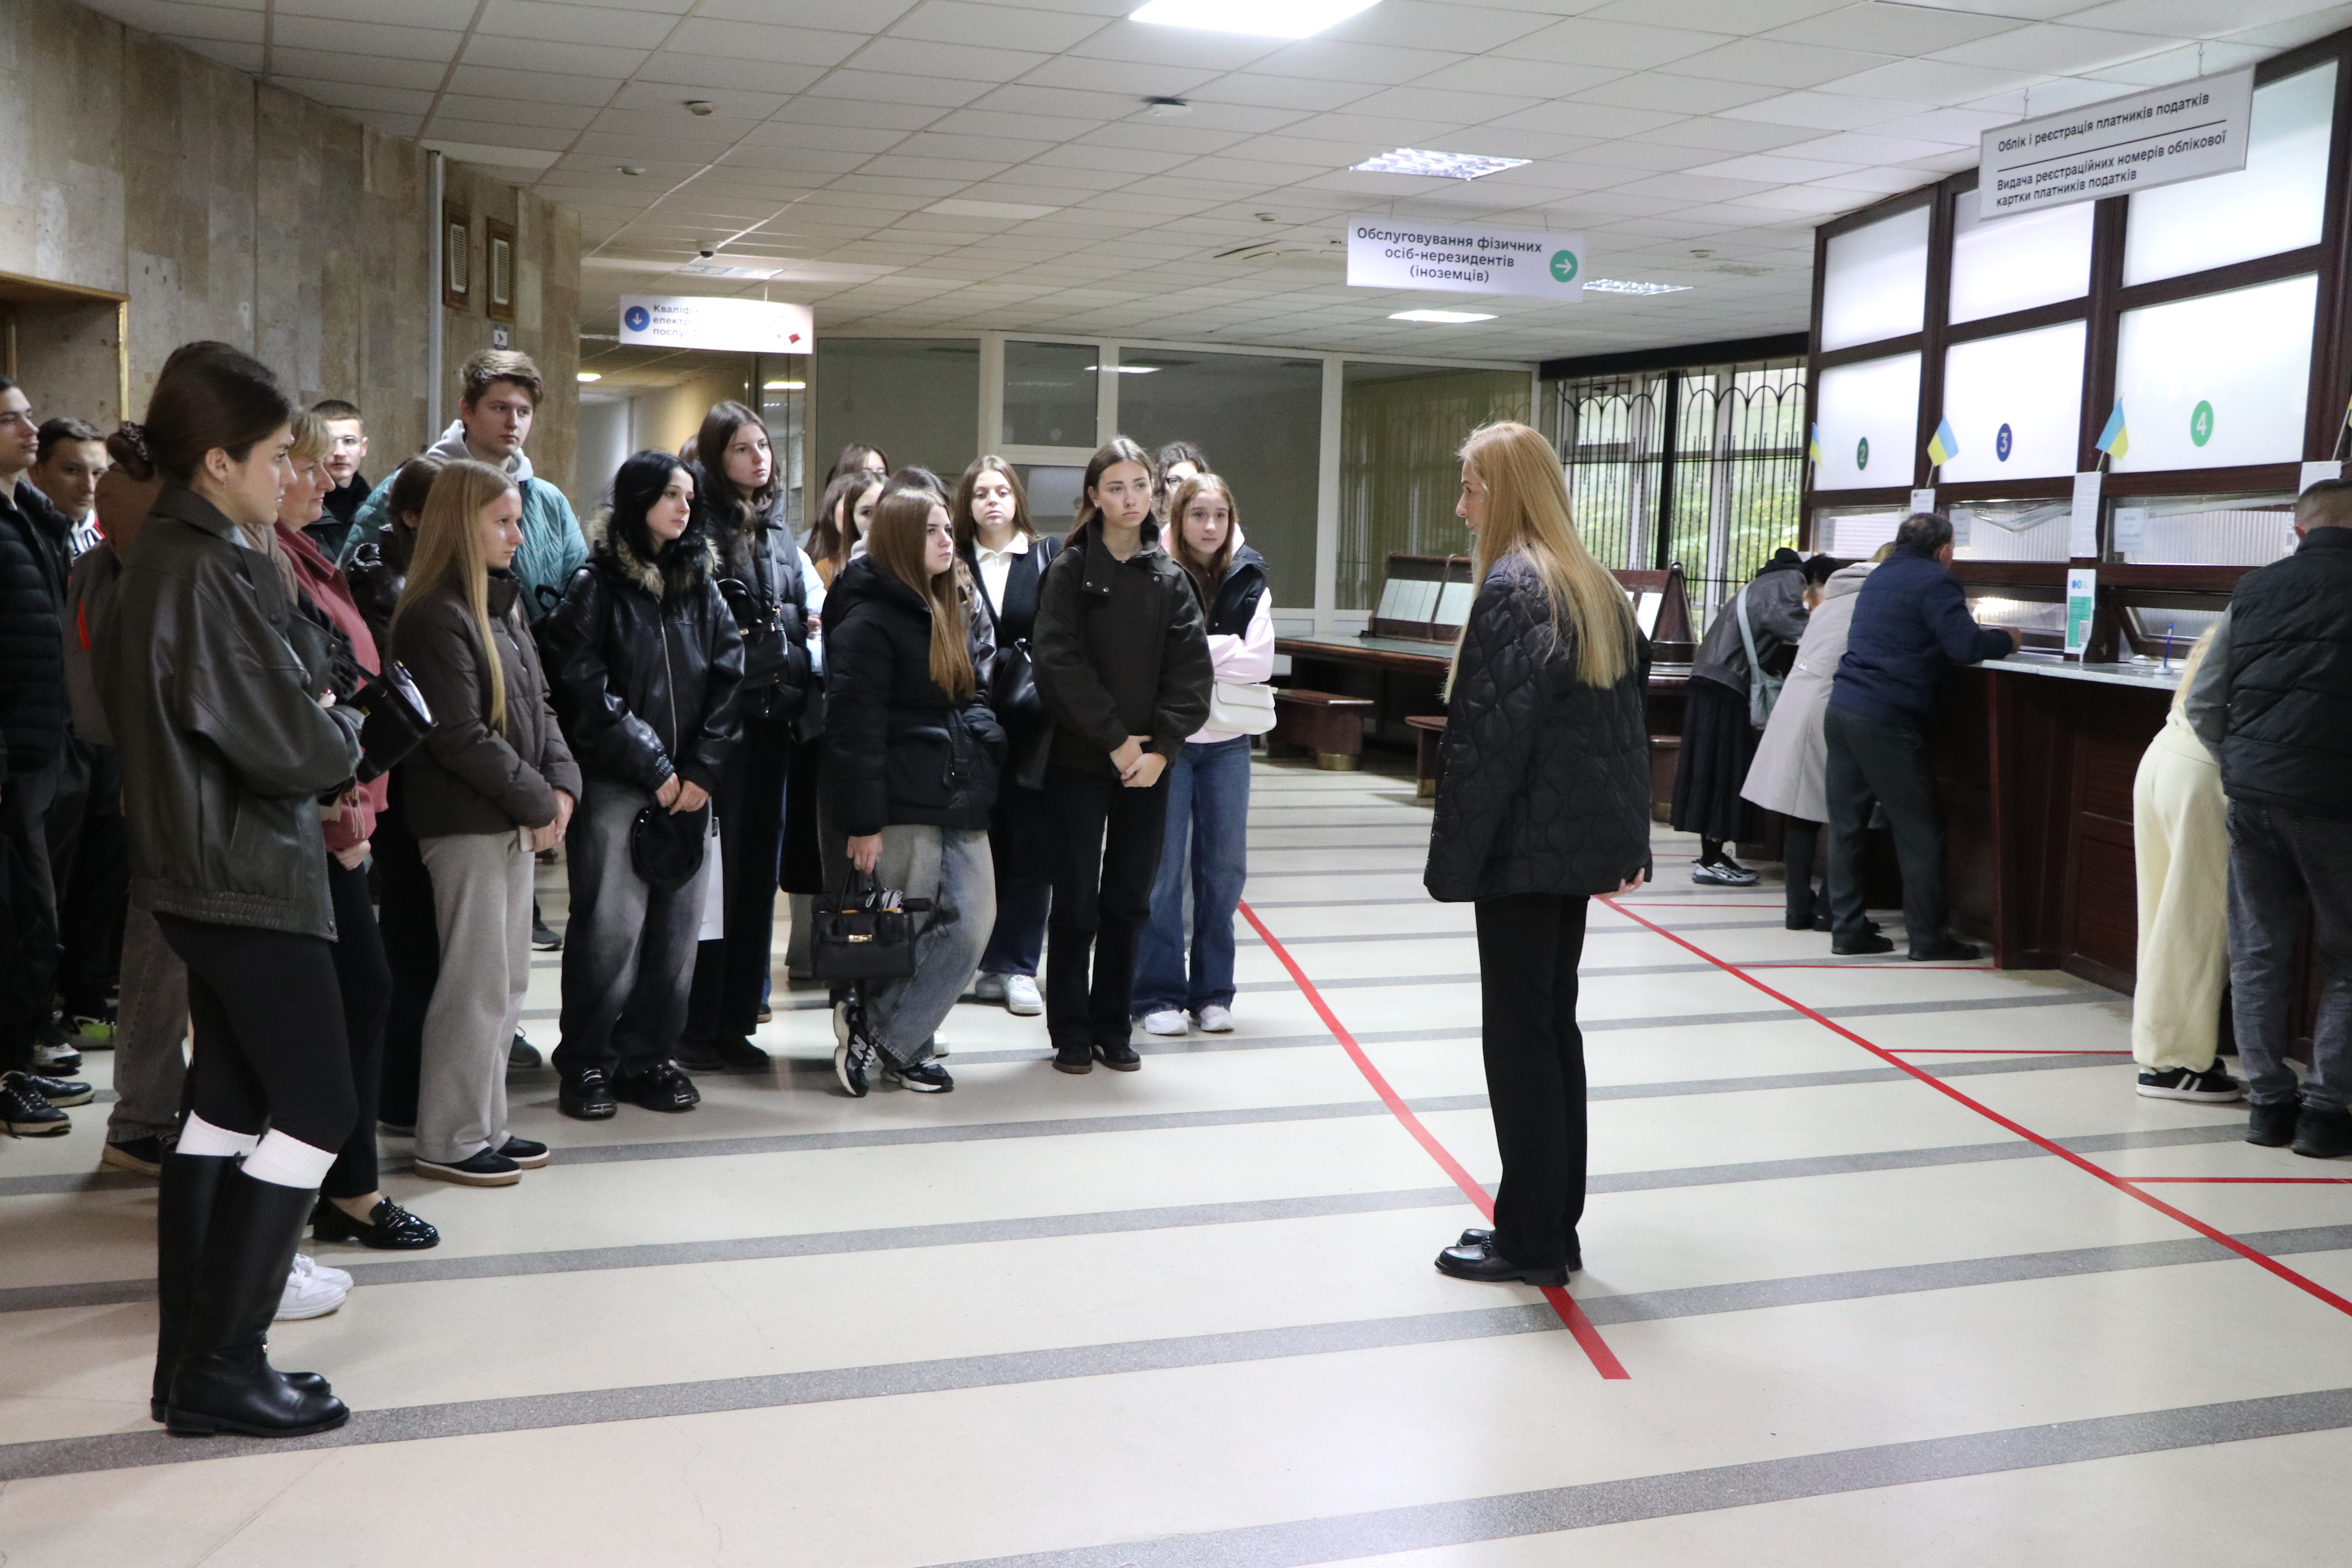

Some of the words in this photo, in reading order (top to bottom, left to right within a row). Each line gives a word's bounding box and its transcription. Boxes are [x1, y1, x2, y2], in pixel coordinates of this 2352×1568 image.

[1998, 136, 2026, 152] Облік
[2029, 133, 2033, 145] і
[2035, 122, 2094, 147] реєстрація
[2096, 105, 2153, 129] платників
[2156, 92, 2210, 115] податків
[1997, 175, 2033, 191] Видача
[2036, 158, 2114, 185] реєстраційних
[2118, 145, 2164, 165] номерів
[2167, 130, 2227, 155] облікової
[1996, 192, 2031, 207] картки
[2034, 179, 2085, 199] платників
[2089, 169, 2137, 189] податків
[1357, 227, 1474, 247] Обслуговування
[1477, 236, 1542, 253] фізичних
[1385, 247, 1514, 267] осіб-нерезидентів
[1410, 265, 1490, 283] (іноземців)
[2196, 412, 2207, 436] 4
[1859, 445, 1866, 463] 2
[2000, 432, 2008, 452] 3
